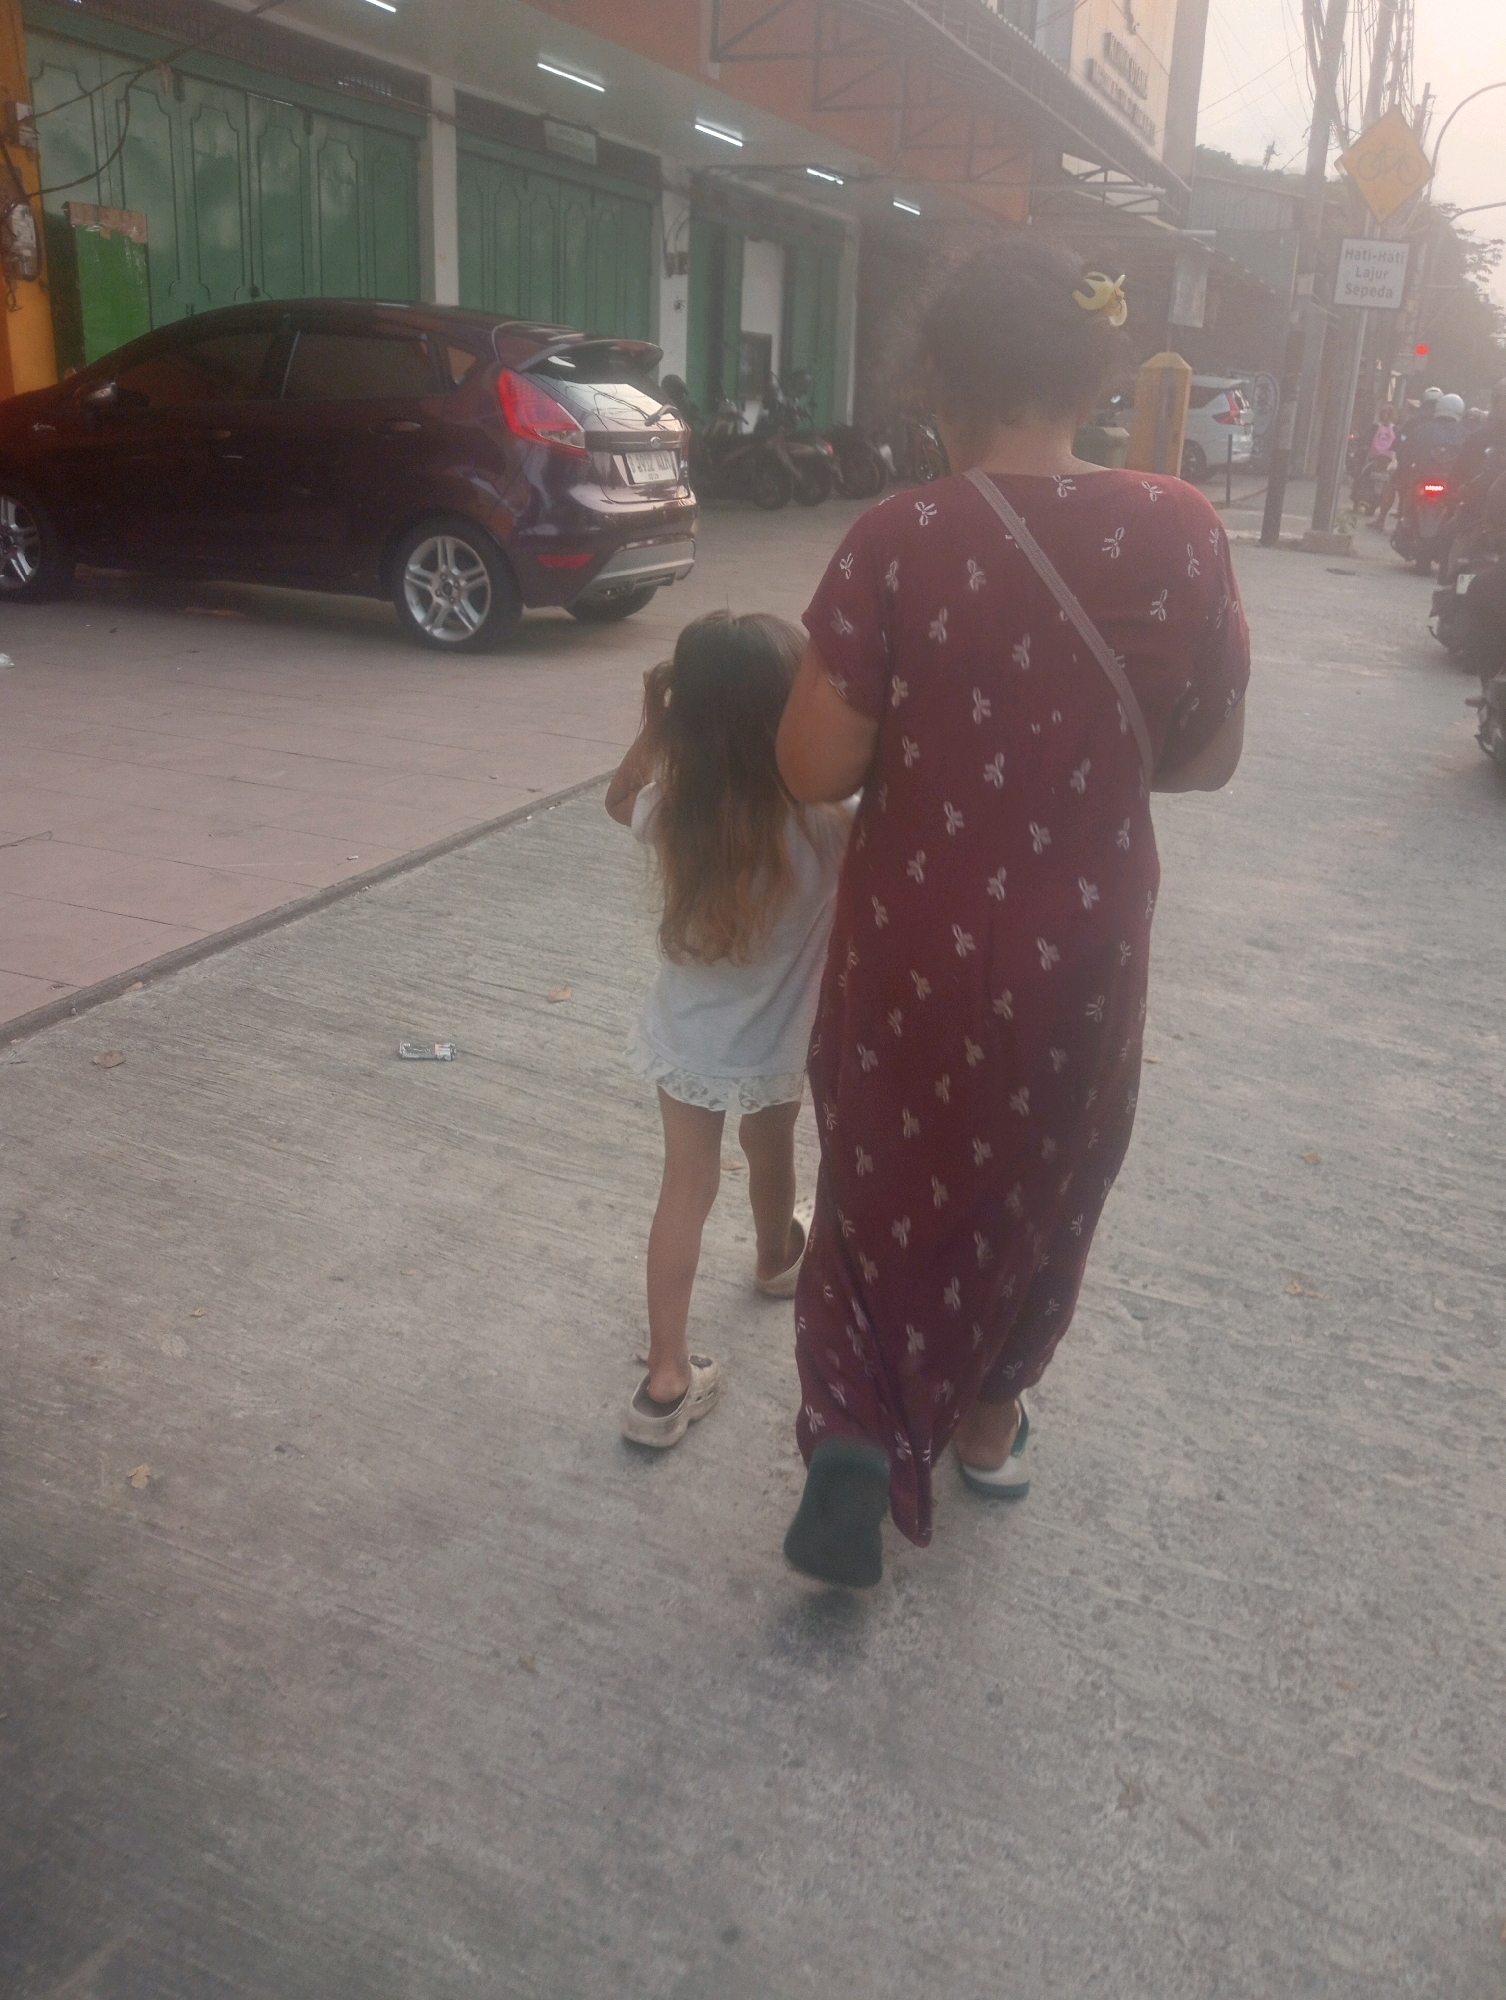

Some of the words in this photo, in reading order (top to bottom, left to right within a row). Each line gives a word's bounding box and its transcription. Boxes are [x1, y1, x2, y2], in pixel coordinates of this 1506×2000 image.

[1345, 249, 1404, 264] Hati-Hati
[1355, 266, 1389, 281] Lajur
[1344, 282, 1393, 299] Sepeda
